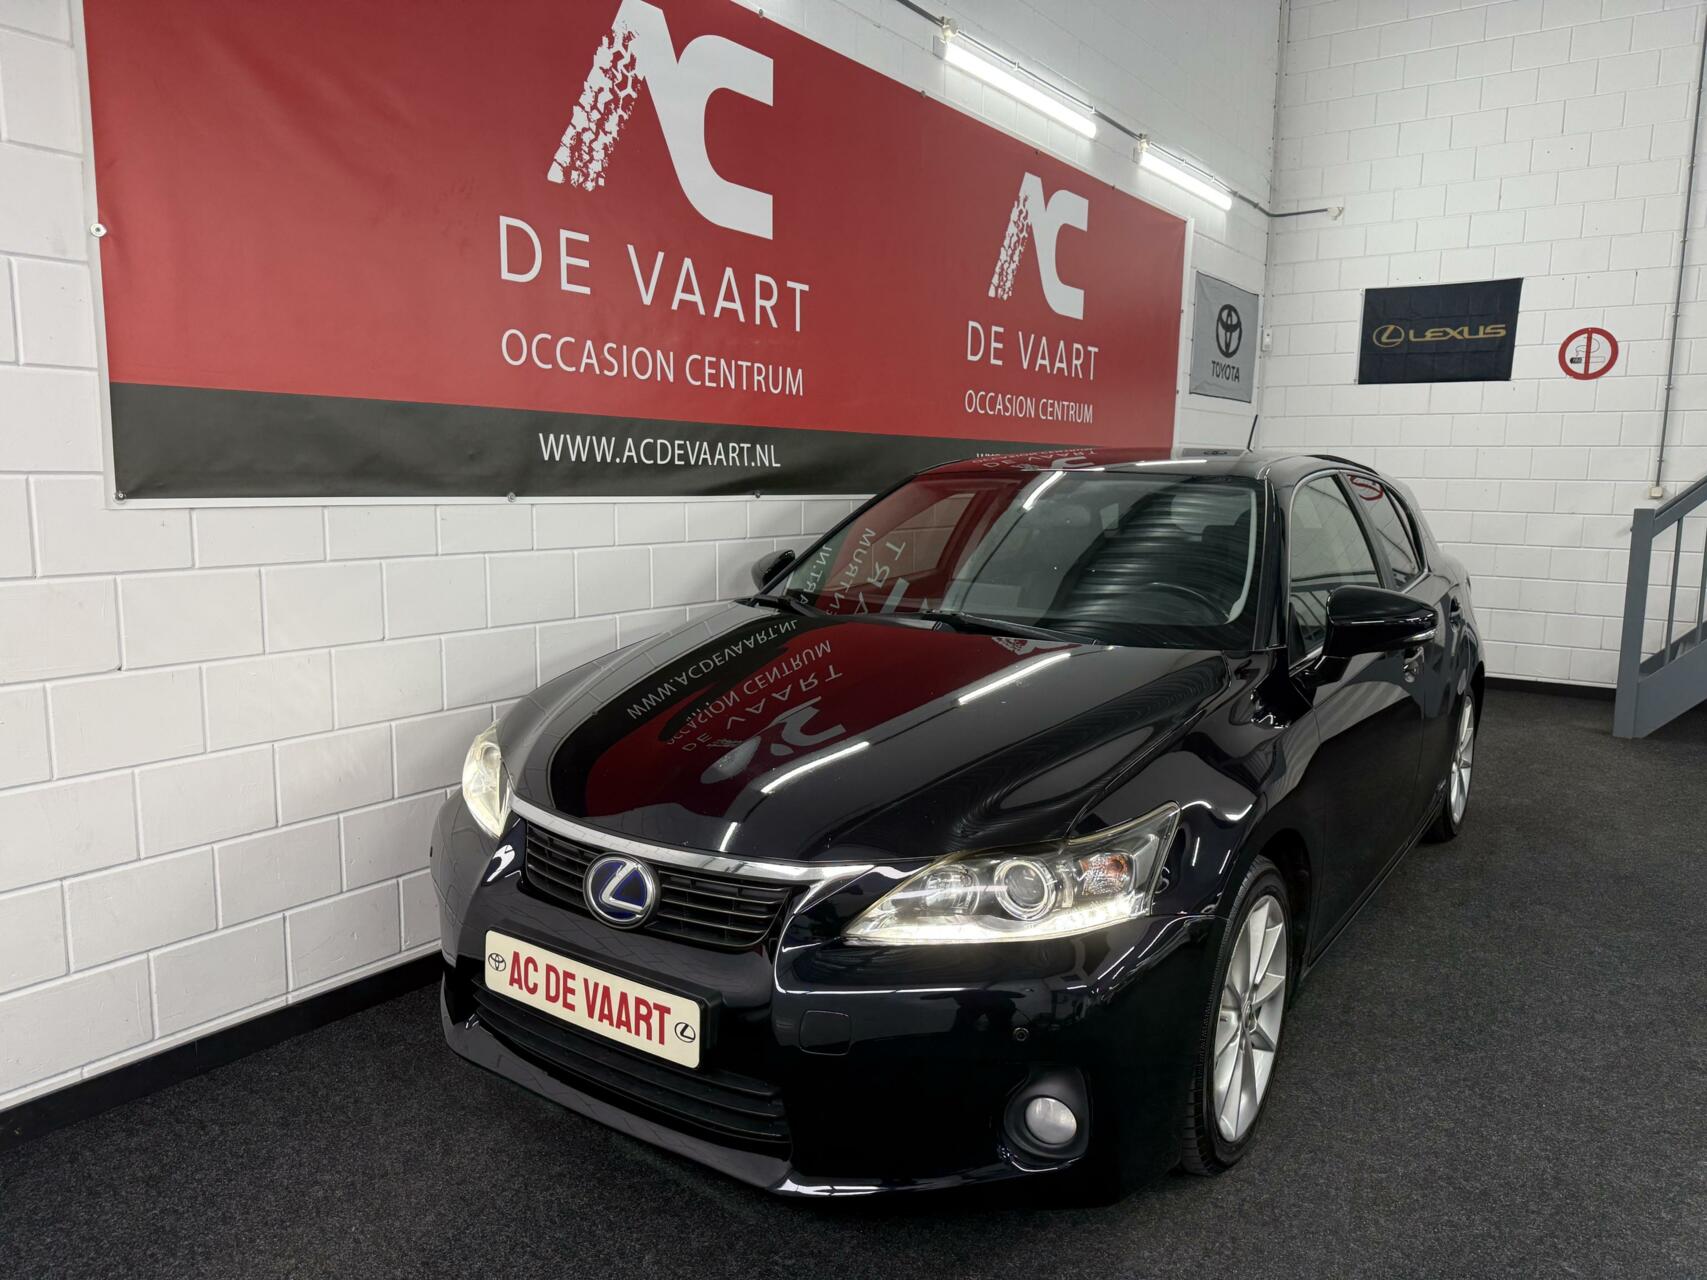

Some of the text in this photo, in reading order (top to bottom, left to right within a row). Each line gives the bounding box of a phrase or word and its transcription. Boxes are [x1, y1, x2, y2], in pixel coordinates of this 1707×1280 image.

[499, 215, 809, 332] DE VAART
[967, 320, 1099, 380] DE VAART
[1408, 324, 1507, 342] LEXUS
[501, 329, 804, 396] OCCASION CENTRUM
[1211, 360, 1240, 382] TOYOTA
[964, 390, 1094, 424] OCCASION CENTRUM
[538, 432, 781, 468] WWW.ACDEVAART.NL
[509, 951, 671, 1045] AC DE VAART
